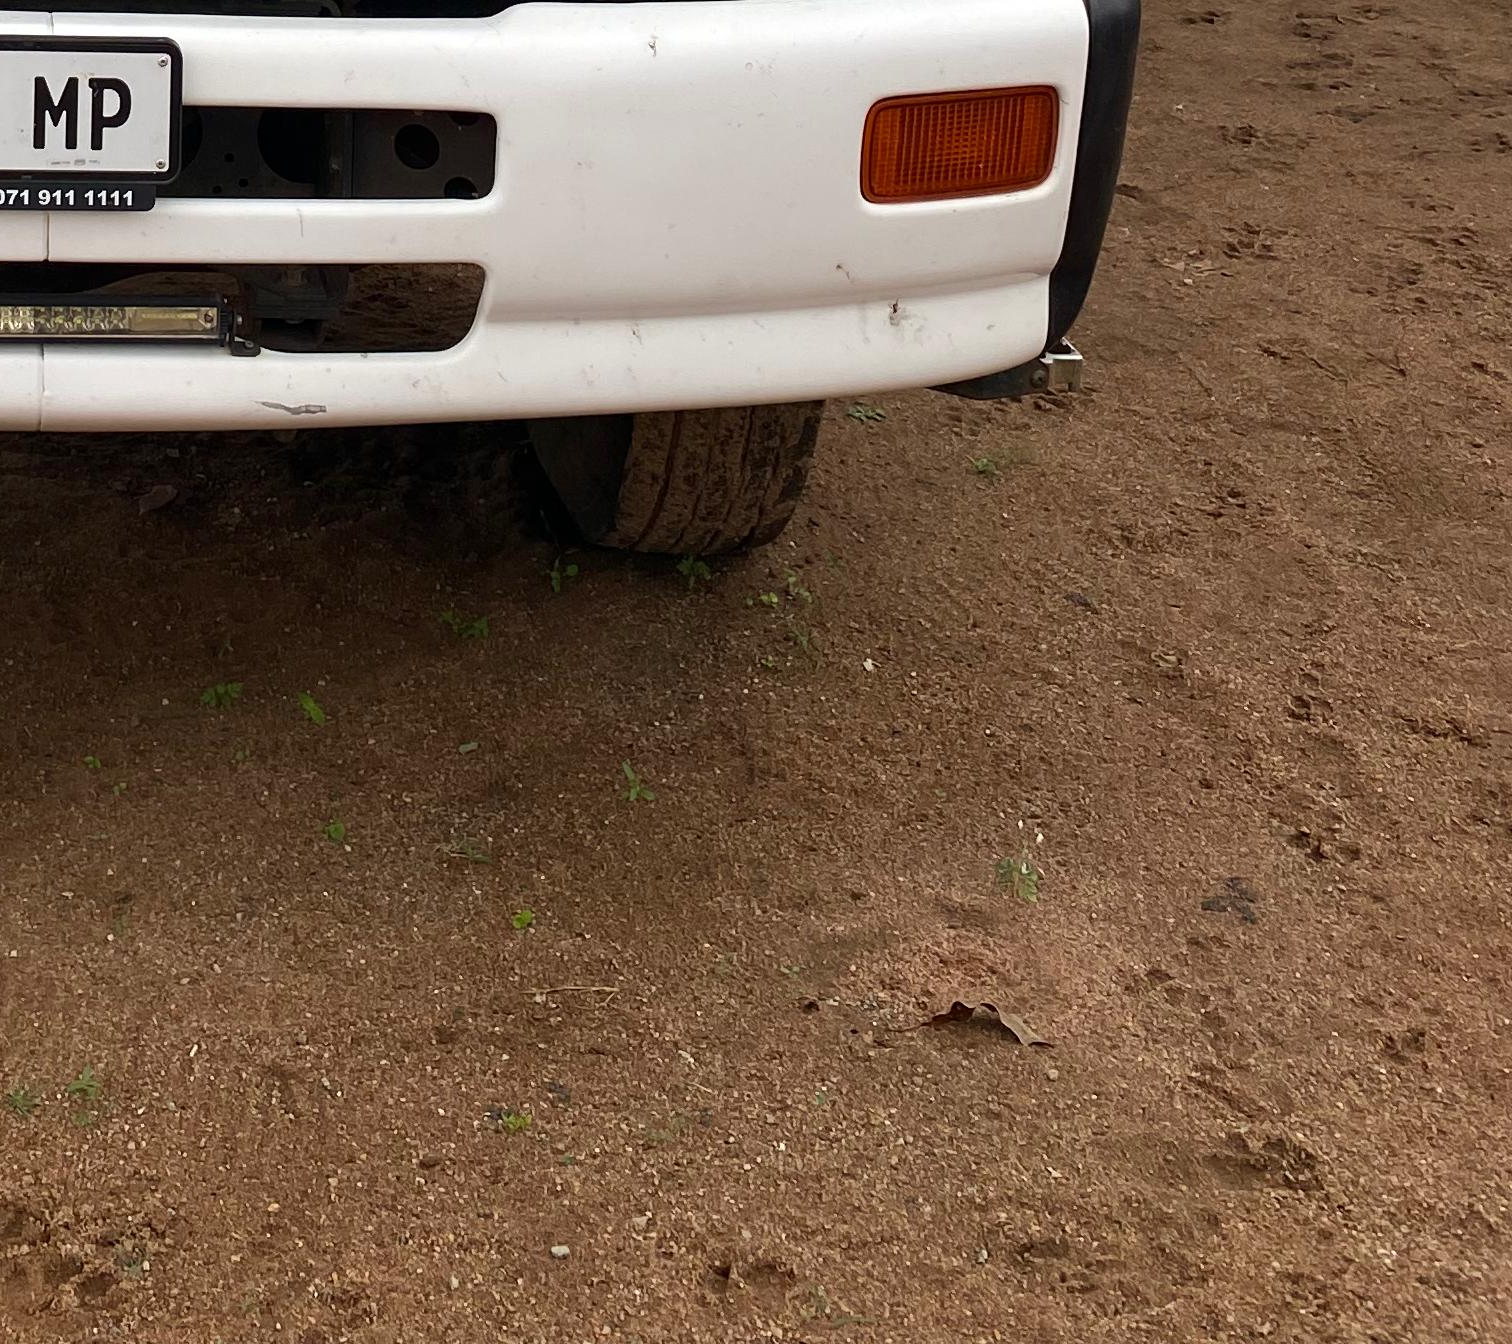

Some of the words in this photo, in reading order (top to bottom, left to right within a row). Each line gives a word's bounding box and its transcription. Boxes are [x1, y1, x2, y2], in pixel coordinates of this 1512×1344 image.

[33, 76, 132, 151] MP
[38, 189, 75, 206] 911
[84, 190, 133, 206] 1111
